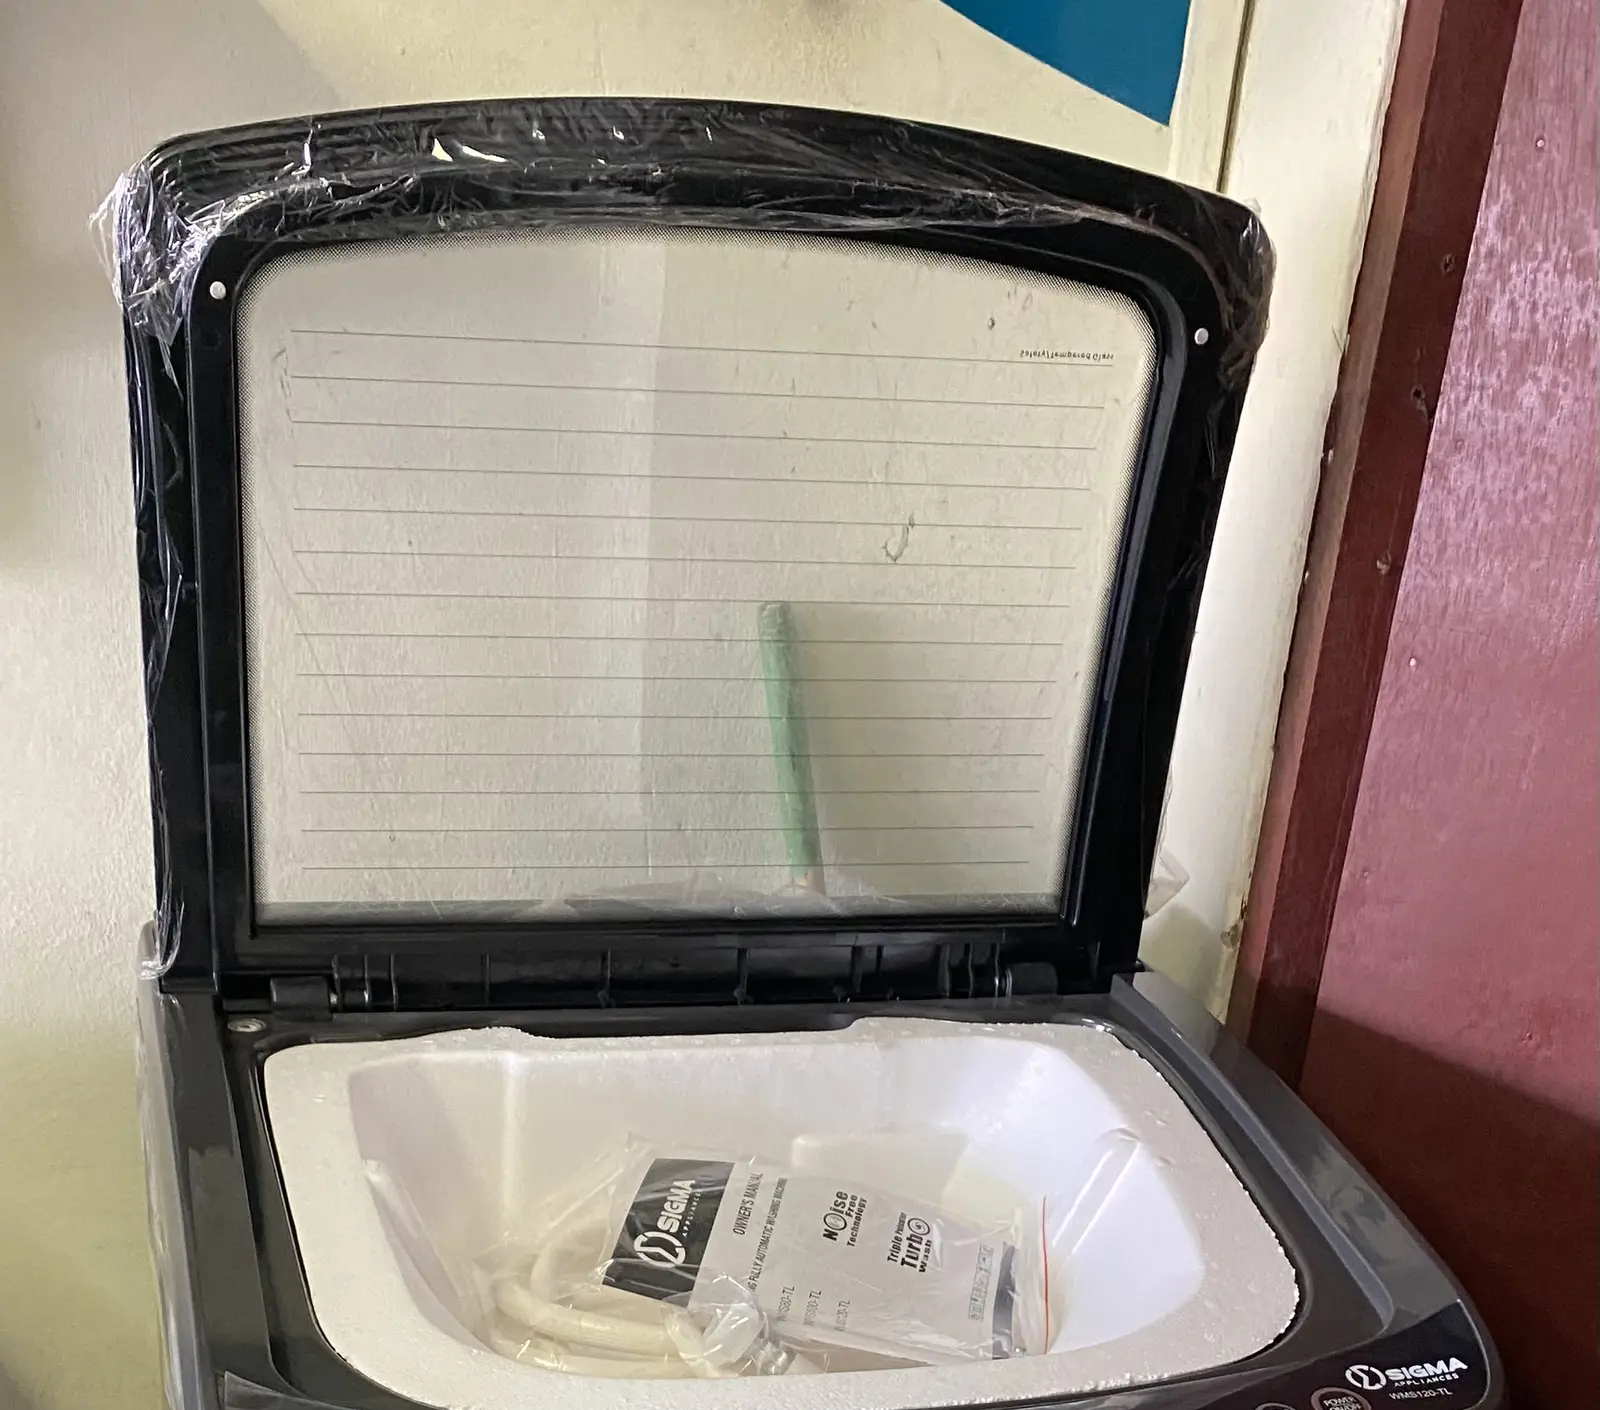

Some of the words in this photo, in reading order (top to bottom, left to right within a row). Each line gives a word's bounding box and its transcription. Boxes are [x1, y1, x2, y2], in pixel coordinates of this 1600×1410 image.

[656, 1179, 696, 1233] SIGMA
[732, 1198, 754, 1236] OWNER'S
[846, 1197, 867, 1247] Technology
[755, 1225, 774, 1264] AUTOMATIC
[887, 1235, 903, 1263] Triple
[919, 1239, 932, 1273] Wash
[1385, 1357, 1468, 1380] SIGMA
[1394, 1372, 1459, 1387] APPLIANCES
[1323, 1396, 1357, 1407] POWER
[1388, 1387, 1453, 1400] WMS120-TL
